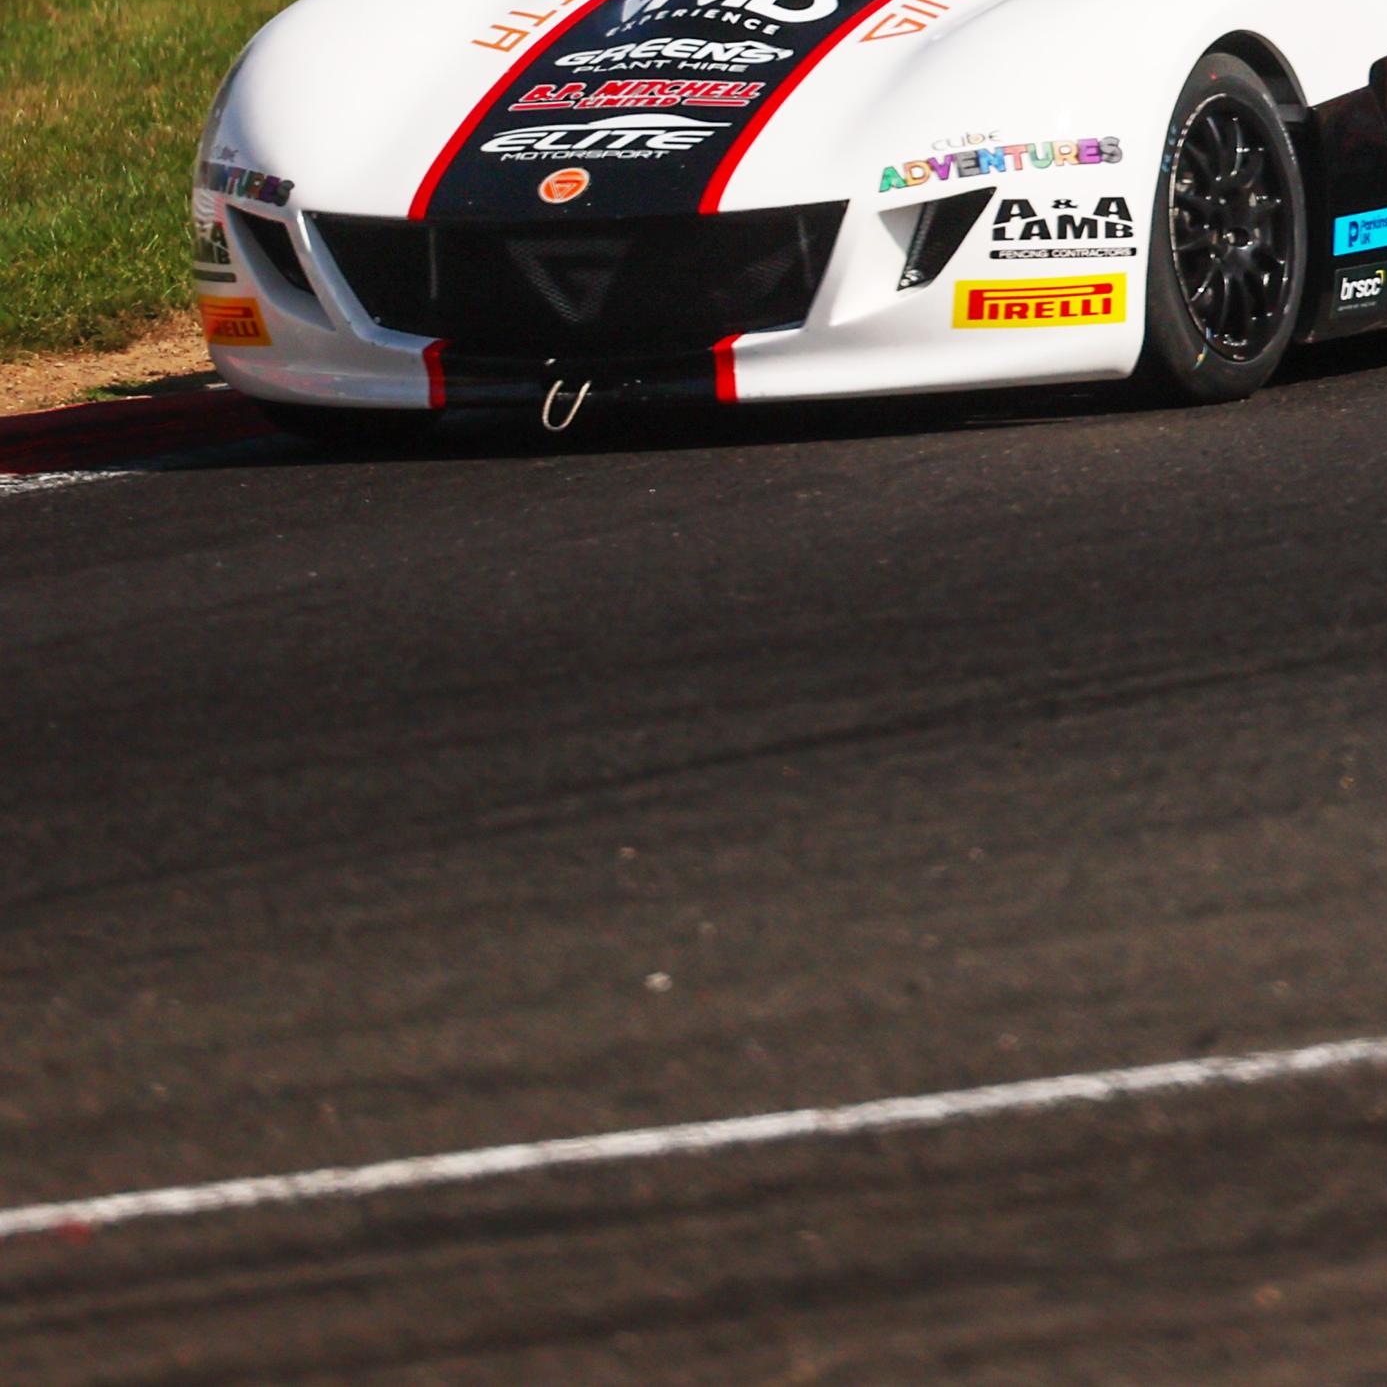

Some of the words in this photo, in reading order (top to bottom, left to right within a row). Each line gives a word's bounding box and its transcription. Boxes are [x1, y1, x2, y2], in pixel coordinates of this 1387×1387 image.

[605, 8, 781, 38] EXPERIENCE
[555, 37, 790, 65] GREENS
[572, 59, 672, 75] PLANT
[677, 60, 750, 73] HIRE
[519, 82, 588, 102] B.P.
[589, 79, 766, 100] MITCHELL
[574, 95, 682, 109] LIMITED
[480, 129, 716, 154] ELITE
[500, 149, 671, 161] MOTORSPORT
[878, 135, 1124, 193] ADVENTURES
[993, 198, 1038, 225] A
[1092, 196, 1133, 222] A
[991, 215, 1134, 241] LAMB
[999, 249, 1049, 259] FENCING
[1052, 247, 1133, 259] CONTRACTORS
[967, 282, 1114, 320] PIRELLI
[1340, 275, 1382, 302] brscc
